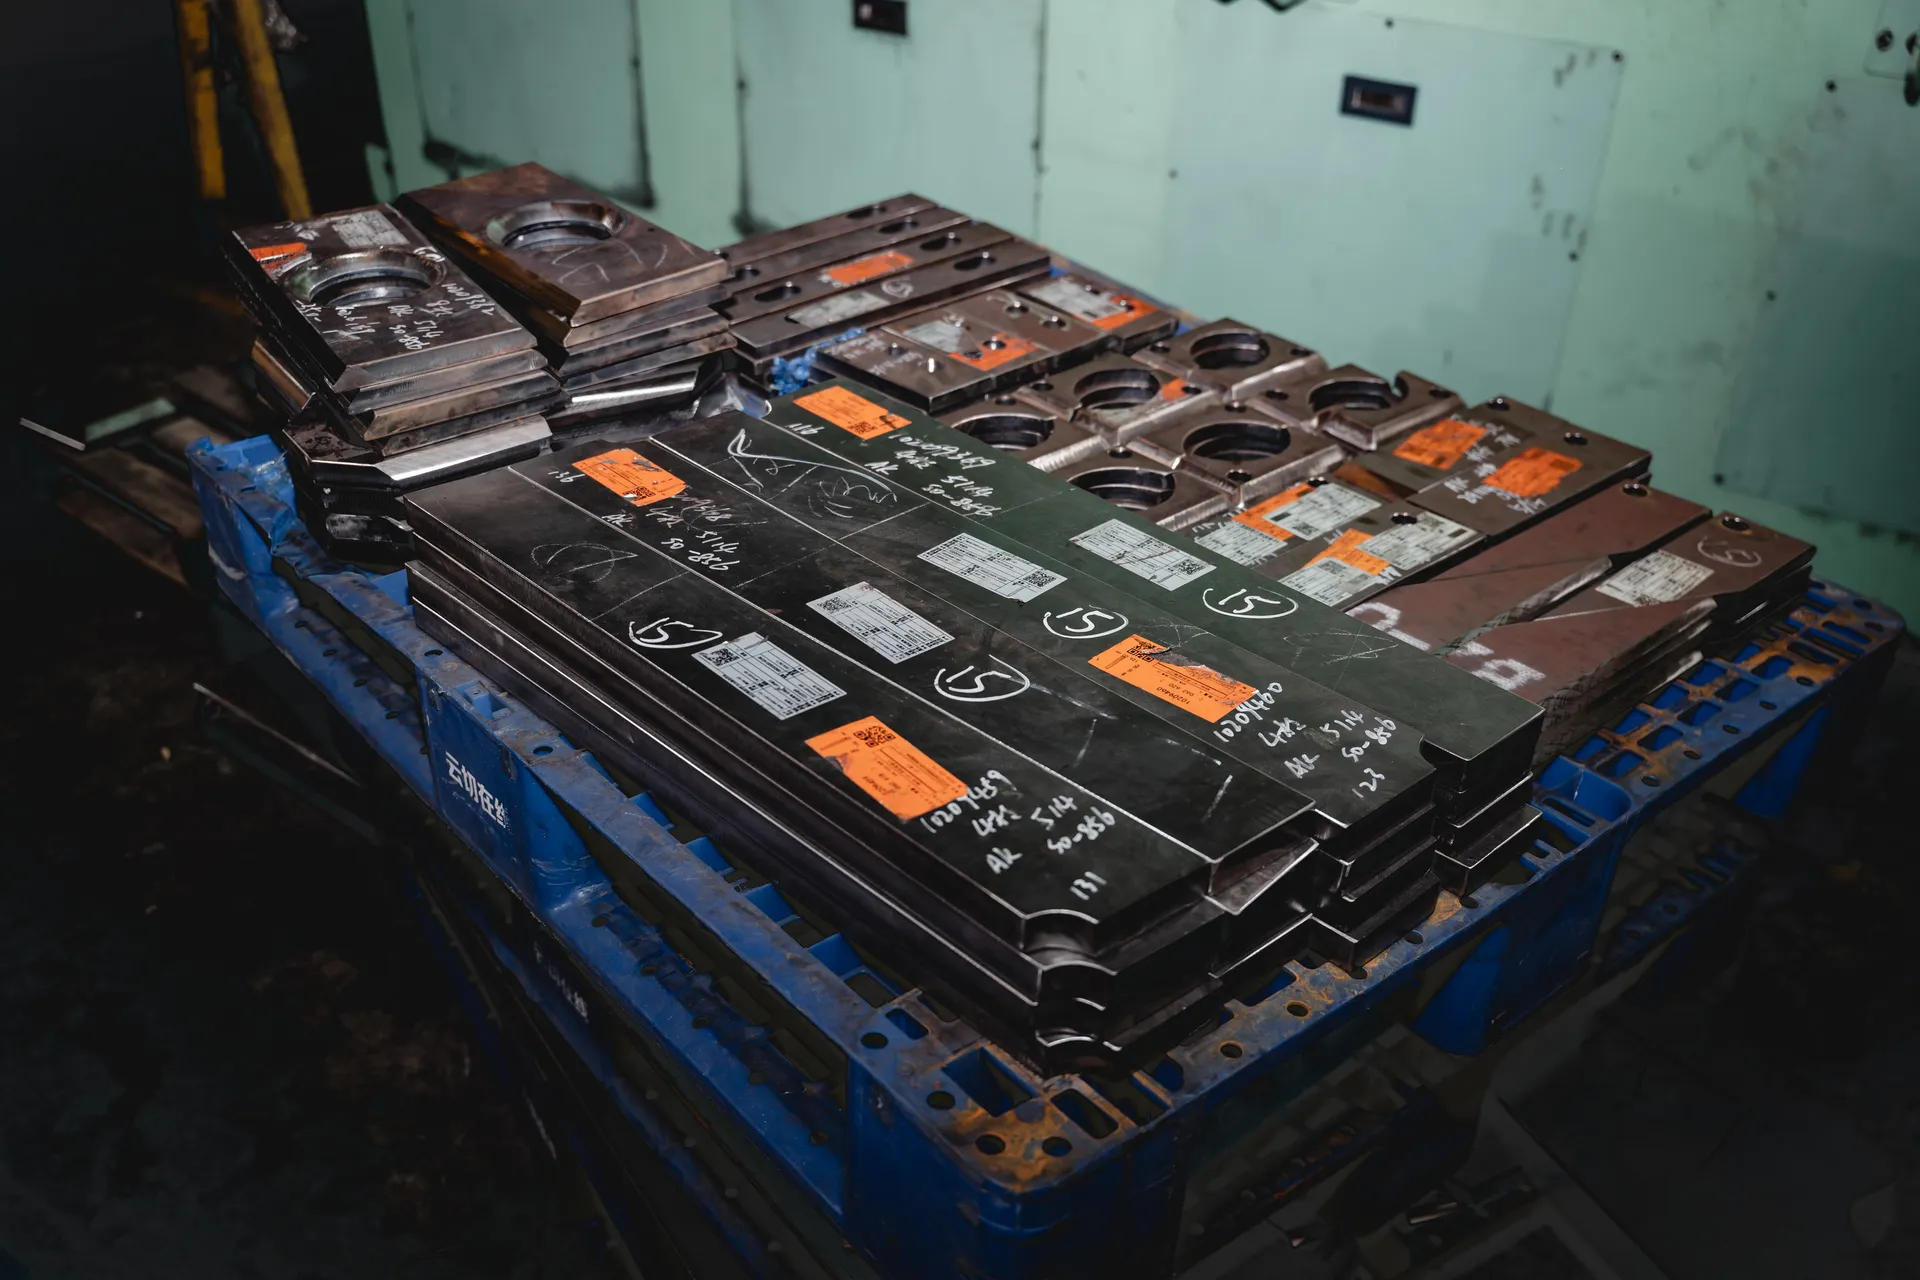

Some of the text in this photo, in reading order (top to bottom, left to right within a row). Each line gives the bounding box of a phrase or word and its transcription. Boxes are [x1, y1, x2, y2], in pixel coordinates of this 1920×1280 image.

[1218, 588, 1281, 614] 15
[1056, 607, 1115, 633] 15
[946, 665, 1012, 694] 15
[1156, 686, 1191, 705] 10209460
[1213, 681, 1282, 743] 10209460
[1351, 767, 1386, 798] 123
[920, 769, 1018, 834] 10209459
[1047, 806, 1116, 855] 50-856
[1069, 871, 1108, 900] 131
